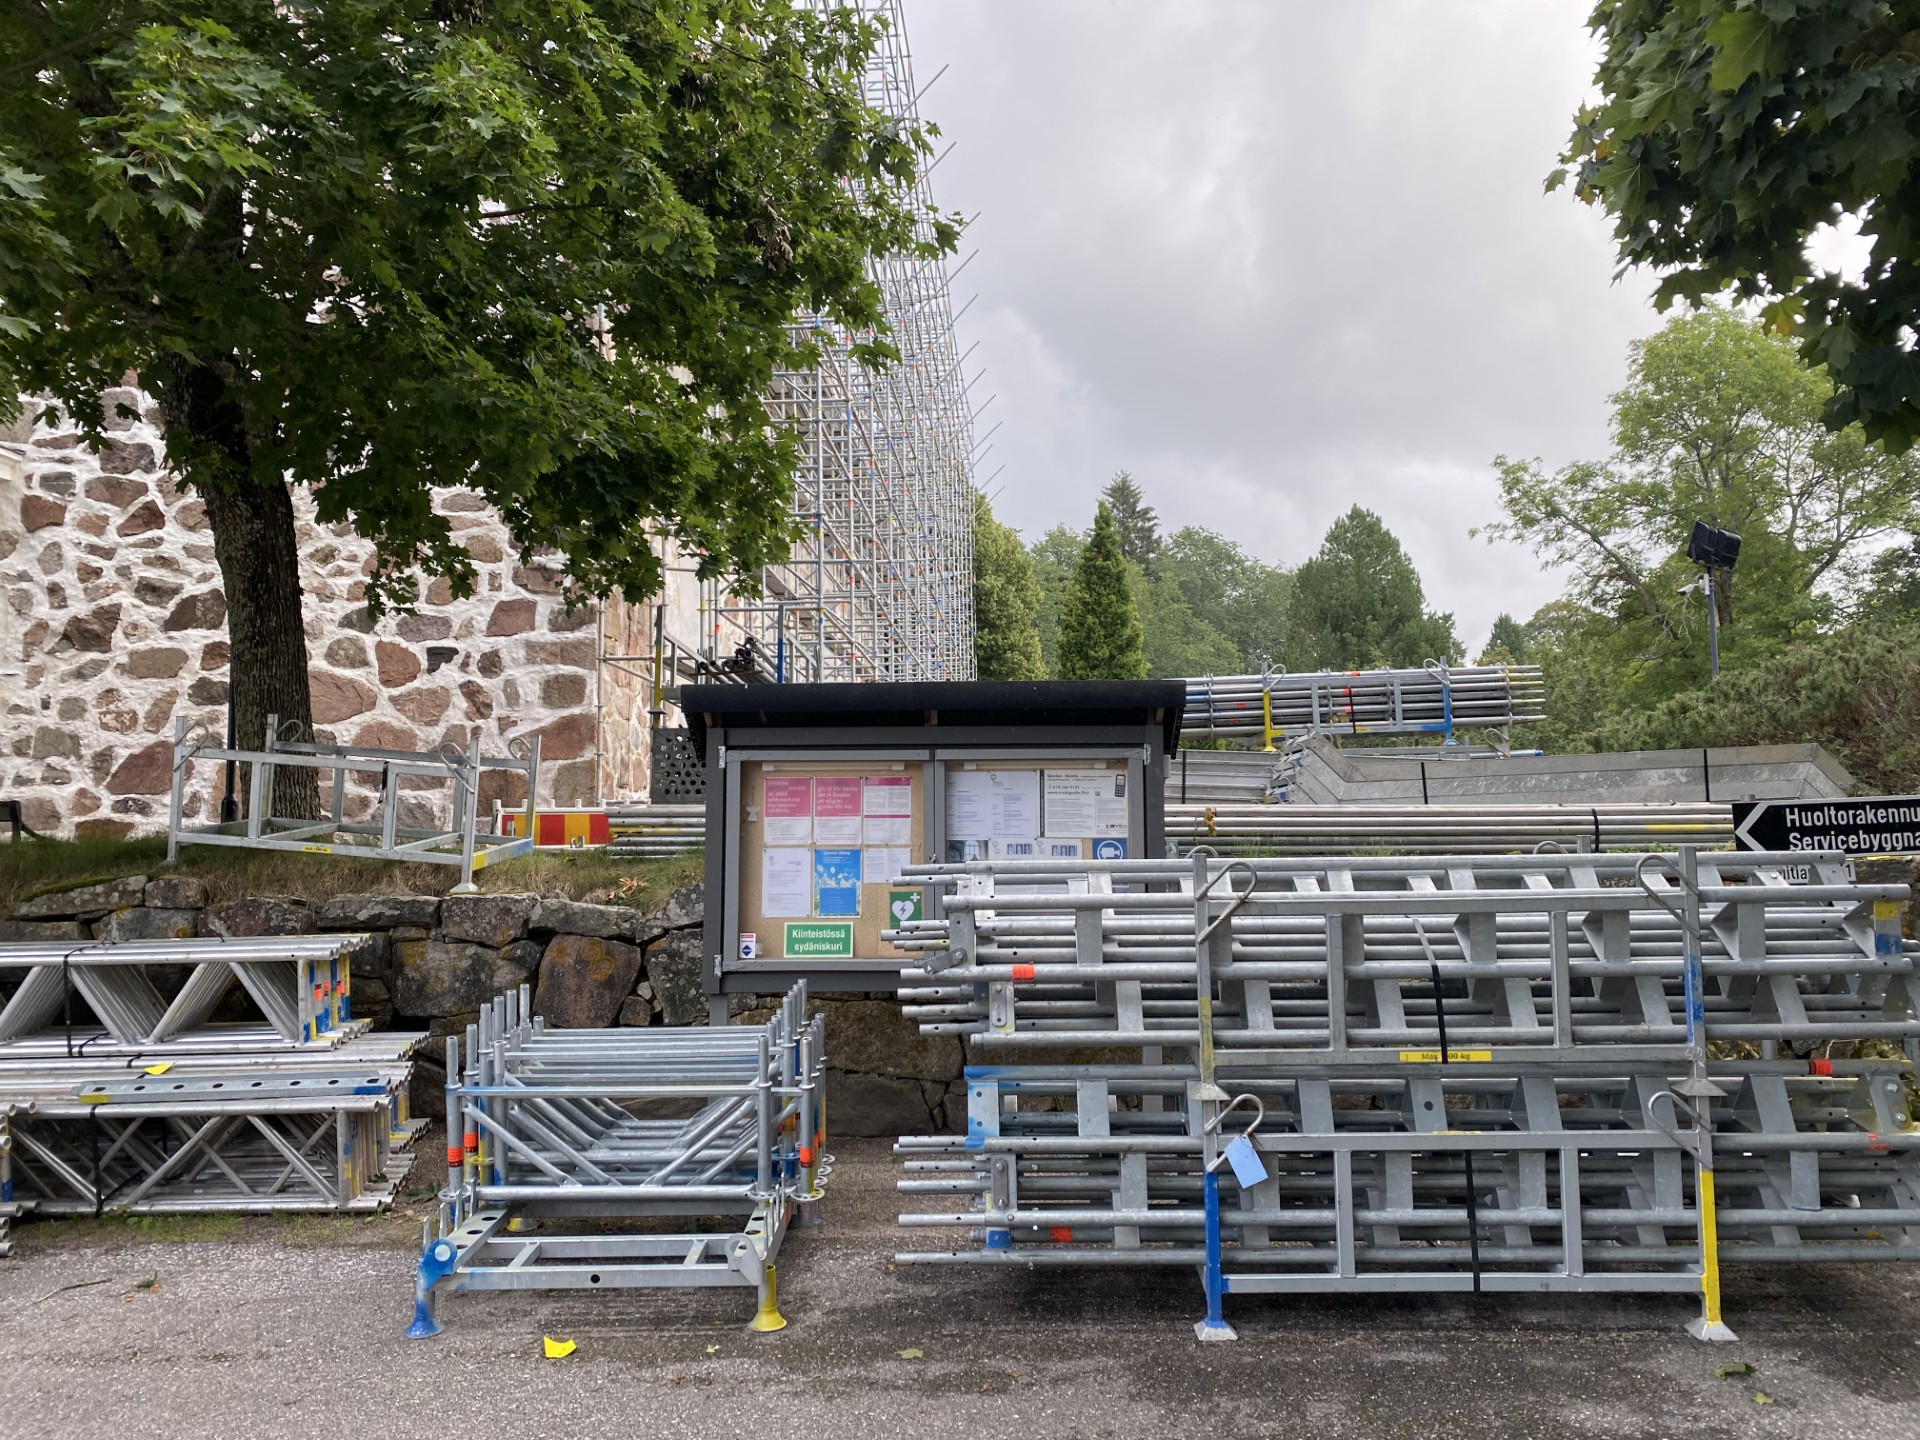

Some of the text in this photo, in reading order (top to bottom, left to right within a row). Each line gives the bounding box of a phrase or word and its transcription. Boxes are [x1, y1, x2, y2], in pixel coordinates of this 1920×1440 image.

[1845, 864, 1852, 878] 1
[792, 928, 846, 939] Kiinteistössä
[794, 942, 843, 953] sydäniskuri
[1460, 1052, 1471, 1061] kg
